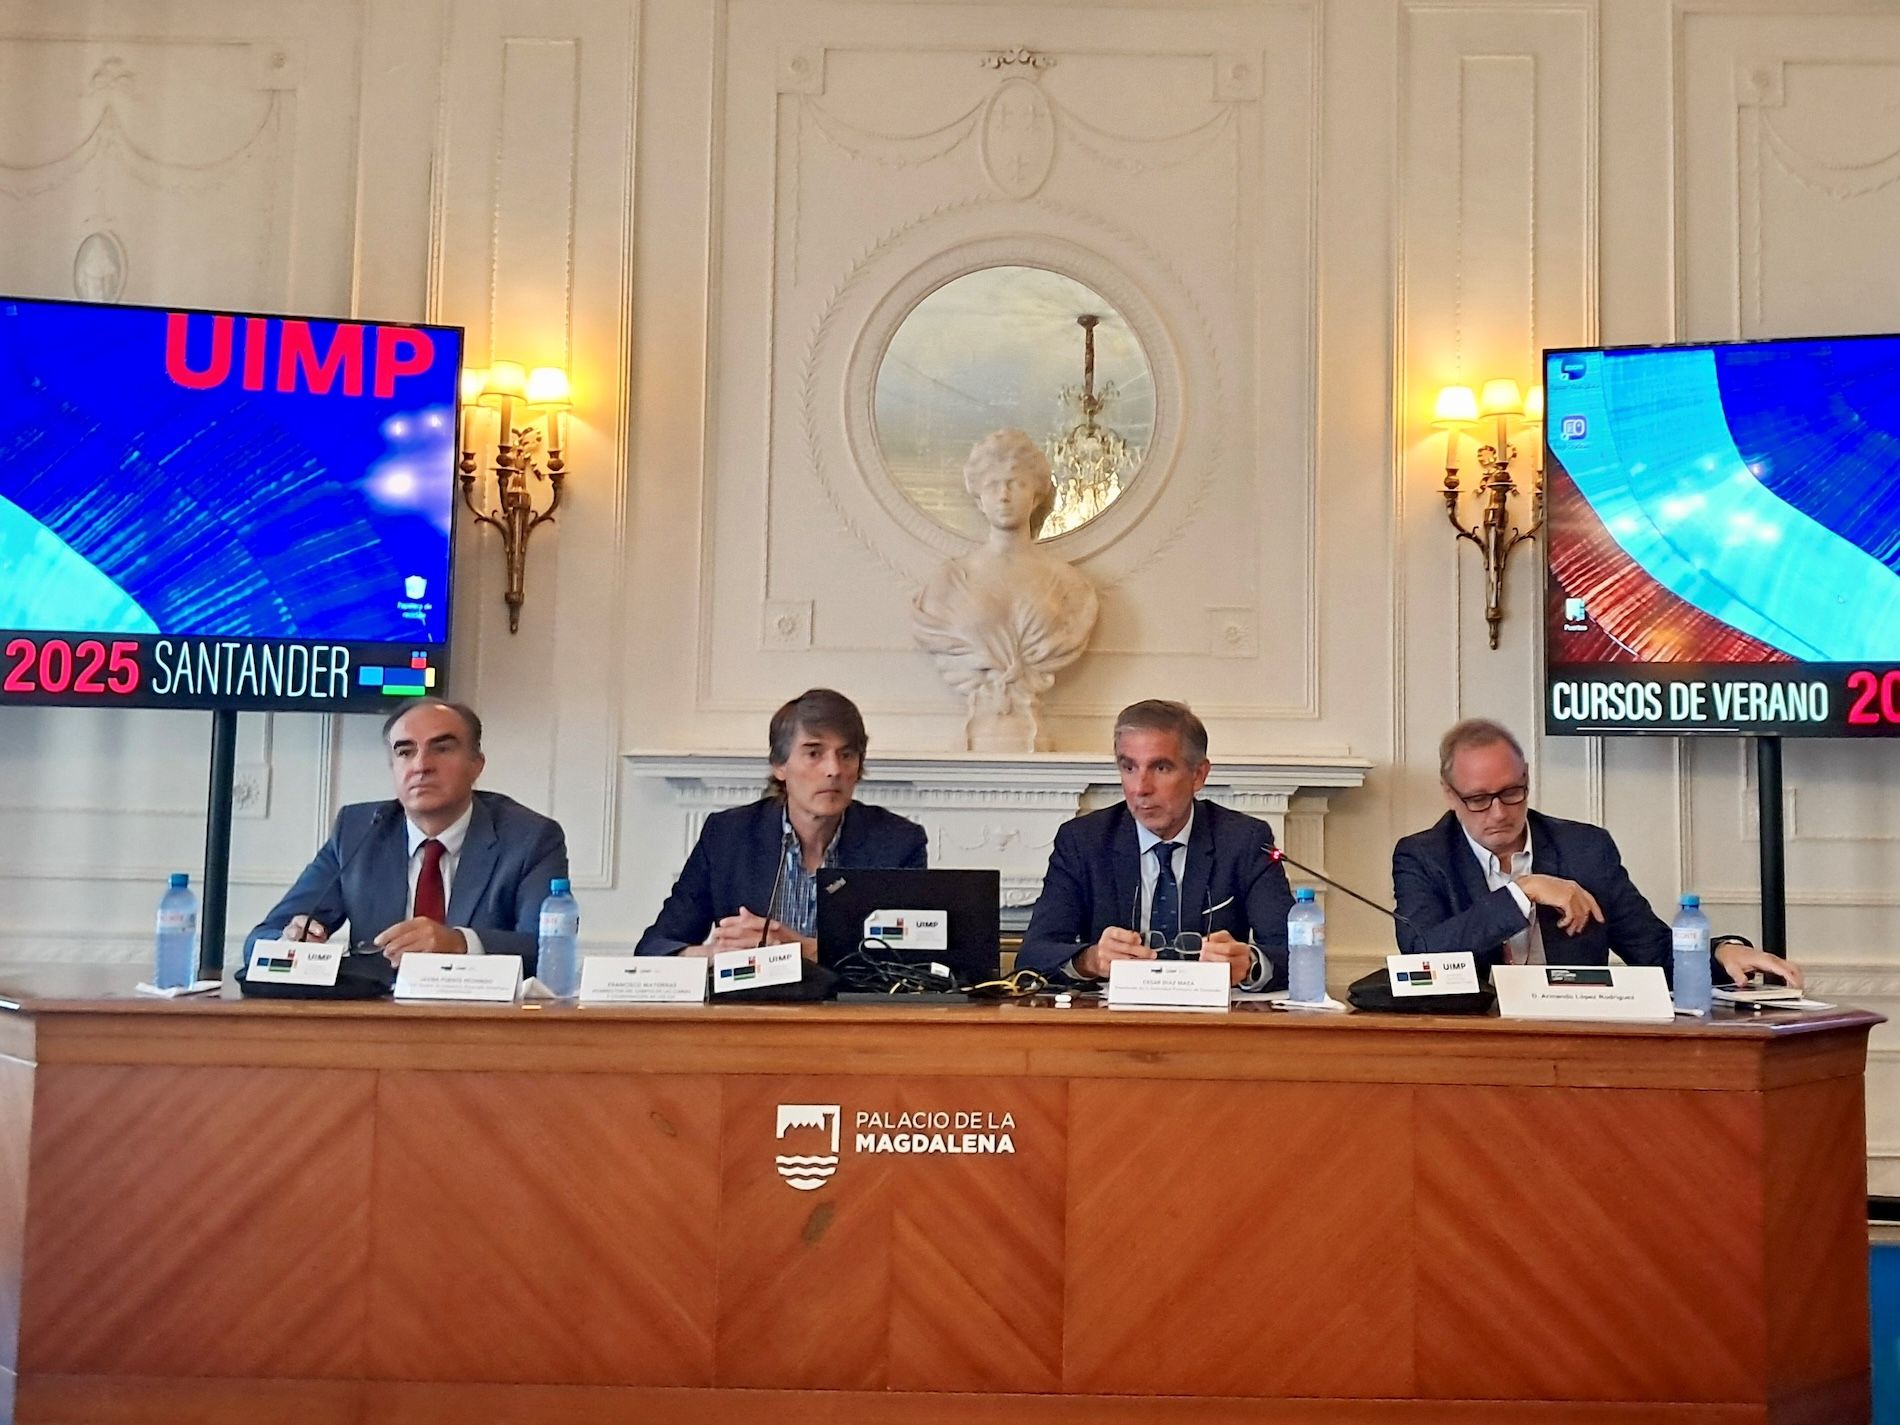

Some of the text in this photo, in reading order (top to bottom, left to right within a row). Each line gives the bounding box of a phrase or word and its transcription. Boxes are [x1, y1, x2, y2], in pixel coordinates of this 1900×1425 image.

[165, 312, 436, 398] UIMP
[3, 638, 350, 699] 2025 SANTANDER
[1552, 681, 1662, 722] CURSOS
[1669, 681, 1707, 721] DE
[1712, 681, 1829, 722] VERANO
[915, 920, 939, 929] UIMP
[306, 952, 332, 961] UIMP
[768, 952, 793, 963] UIMP
[1442, 962, 1466, 971] UIMP
[856, 1111, 1015, 1129] PALACIO DE LA
[855, 1133, 1015, 1153] MAGDALENA
